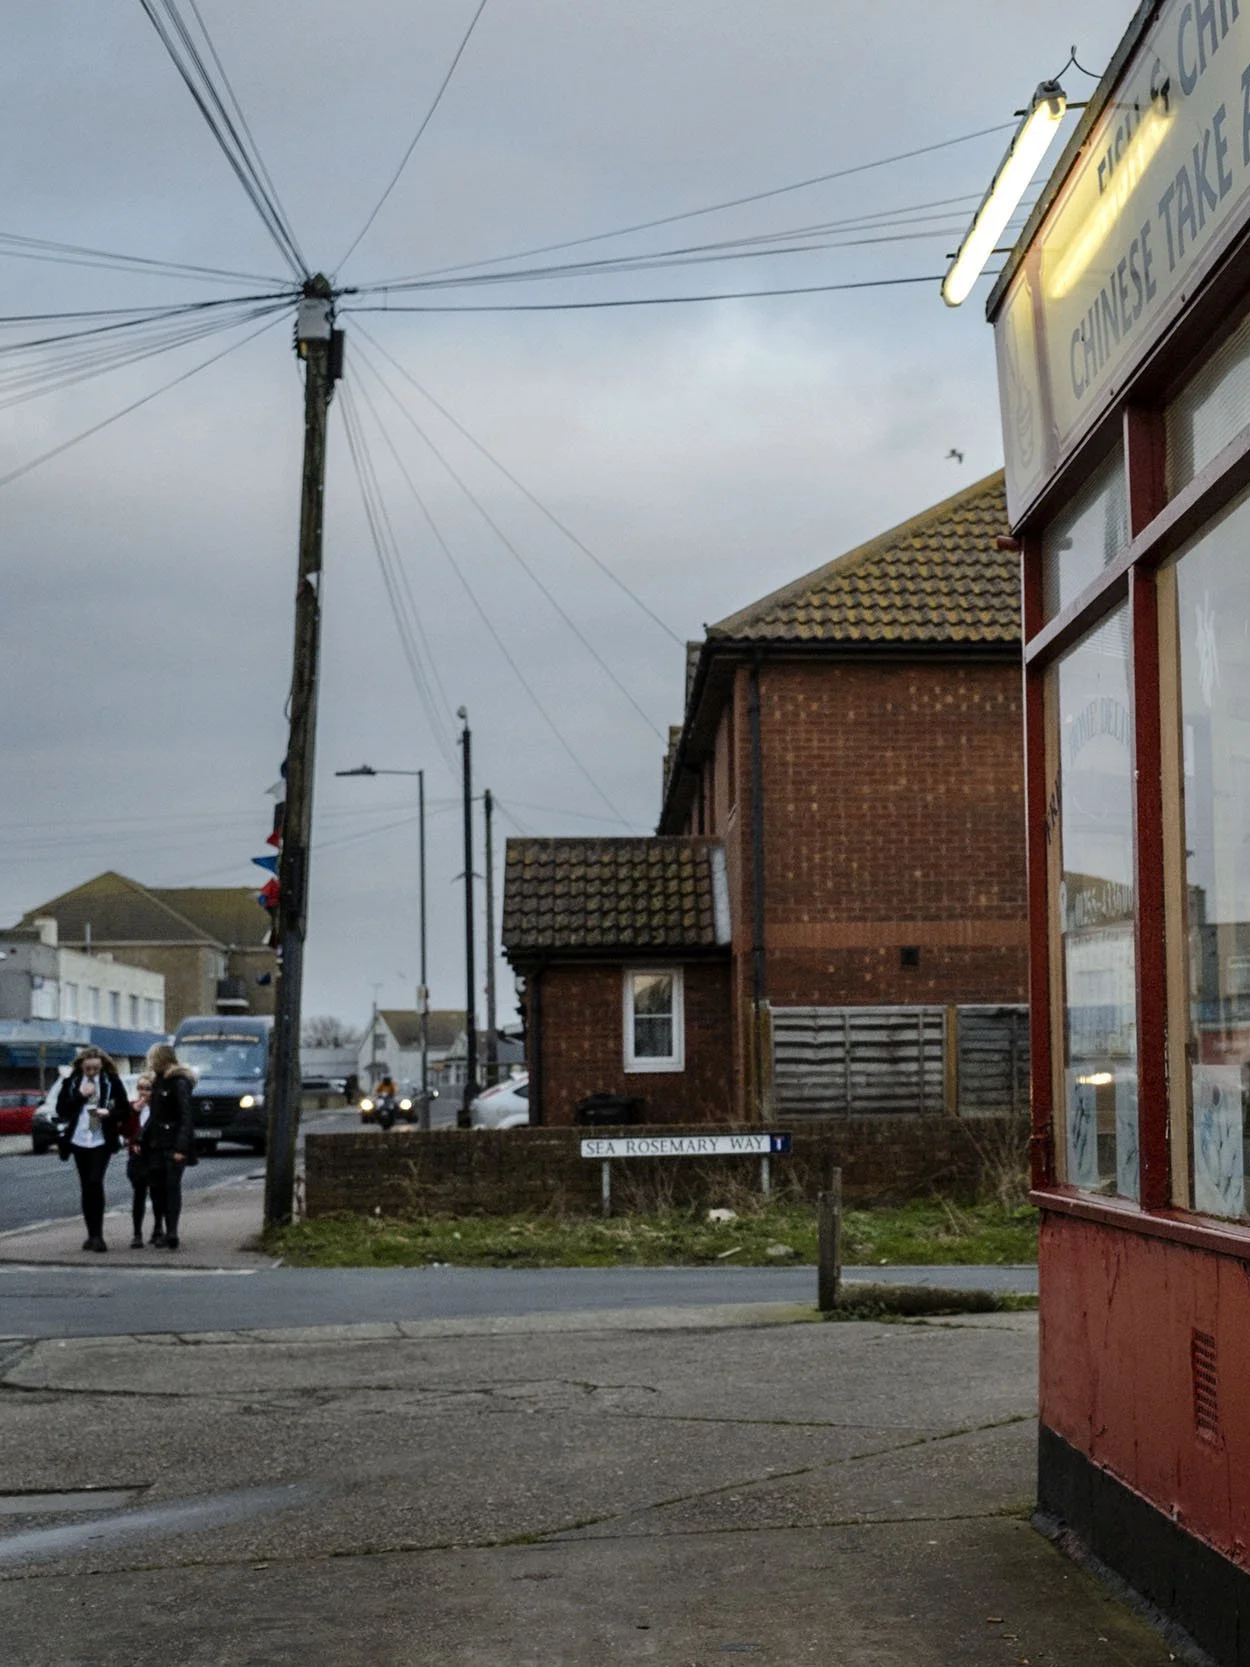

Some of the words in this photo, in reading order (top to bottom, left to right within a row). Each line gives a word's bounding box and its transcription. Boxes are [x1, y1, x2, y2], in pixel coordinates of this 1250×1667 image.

[1070, 219, 1154, 401] CHINESE
[1158, 103, 1234, 273] TAKE
[586, 1140, 616, 1156] SEA
[626, 1138, 719, 1154] ROSEMARY
[730, 1135, 766, 1150] WAY
